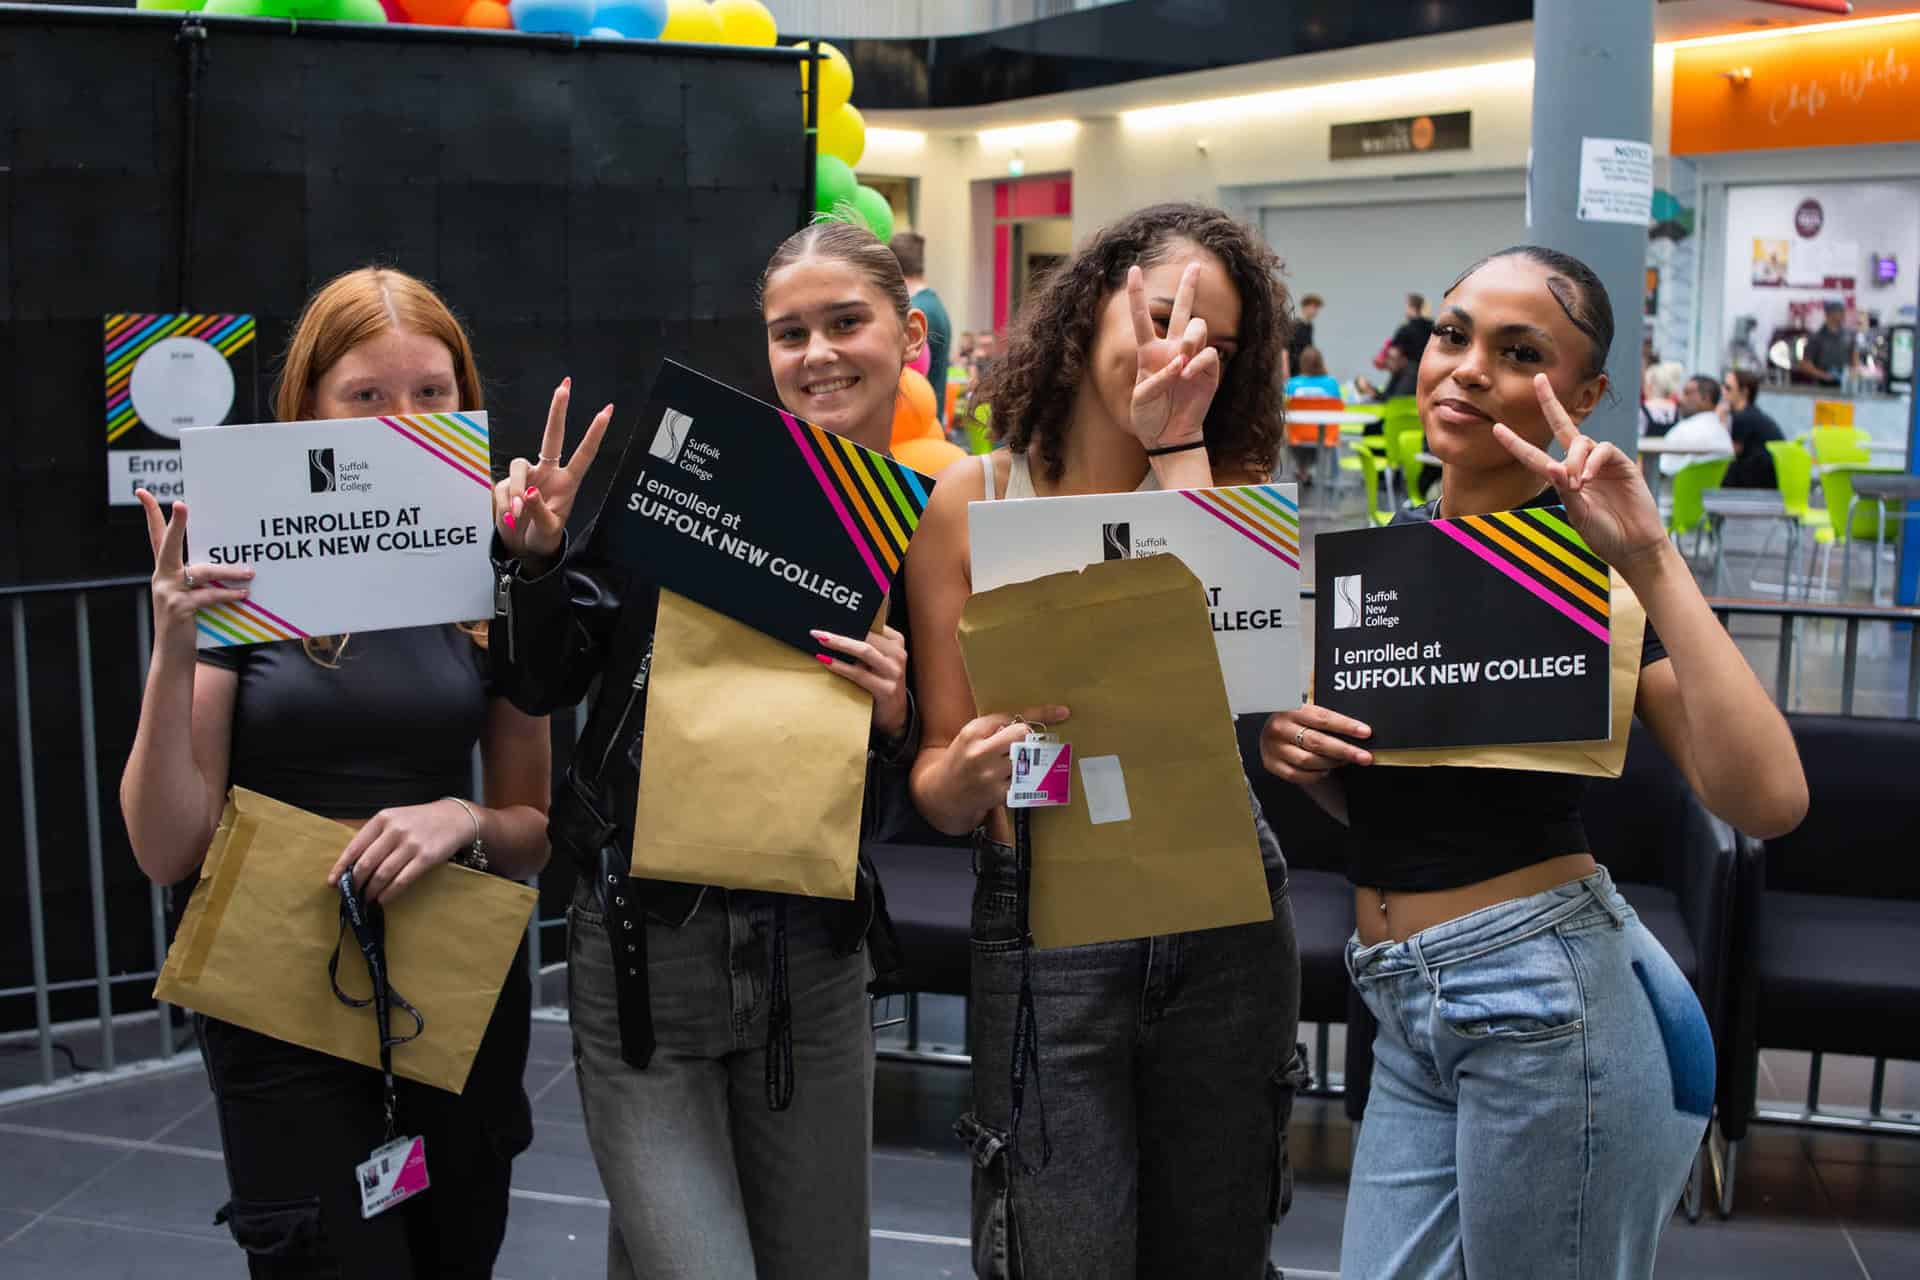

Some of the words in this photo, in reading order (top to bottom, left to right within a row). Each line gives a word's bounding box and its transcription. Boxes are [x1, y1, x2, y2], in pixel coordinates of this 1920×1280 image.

[683, 449, 706, 465] New
[688, 438, 721, 461] Suffolk
[339, 462, 369, 472] Suffolk
[340, 473, 360, 482] New
[679, 459, 713, 481] College
[340, 481, 373, 493] College
[636, 470, 646, 488] I
[646, 478, 721, 521] enrolled
[721, 511, 742, 531] at
[260, 518, 267, 538] I
[272, 510, 391, 537] ENROLLED
[396, 506, 422, 527] AT
[208, 538, 313, 565] SUFFOLK
[319, 534, 371, 555] NEW
[376, 526, 479, 552] COLLEGE
[627, 492, 719, 547] SUFFOLK
[718, 533, 769, 568] NEW
[769, 557, 864, 611] COLLEGE
[1135, 536, 1167, 548] Suffolk
[1365, 590, 1399, 603] Suffolk
[1210, 609, 1282, 632] LLEGE
[1365, 604, 1388, 615] New
[1365, 614, 1400, 629] College
[1334, 647, 1340, 665] I
[1344, 641, 1418, 665] enrolled
[1423, 640, 1441, 659] at
[1334, 664, 1426, 691] SUFFOLK
[1430, 662, 1481, 686] NEW
[1484, 654, 1587, 681] COLLEGE
